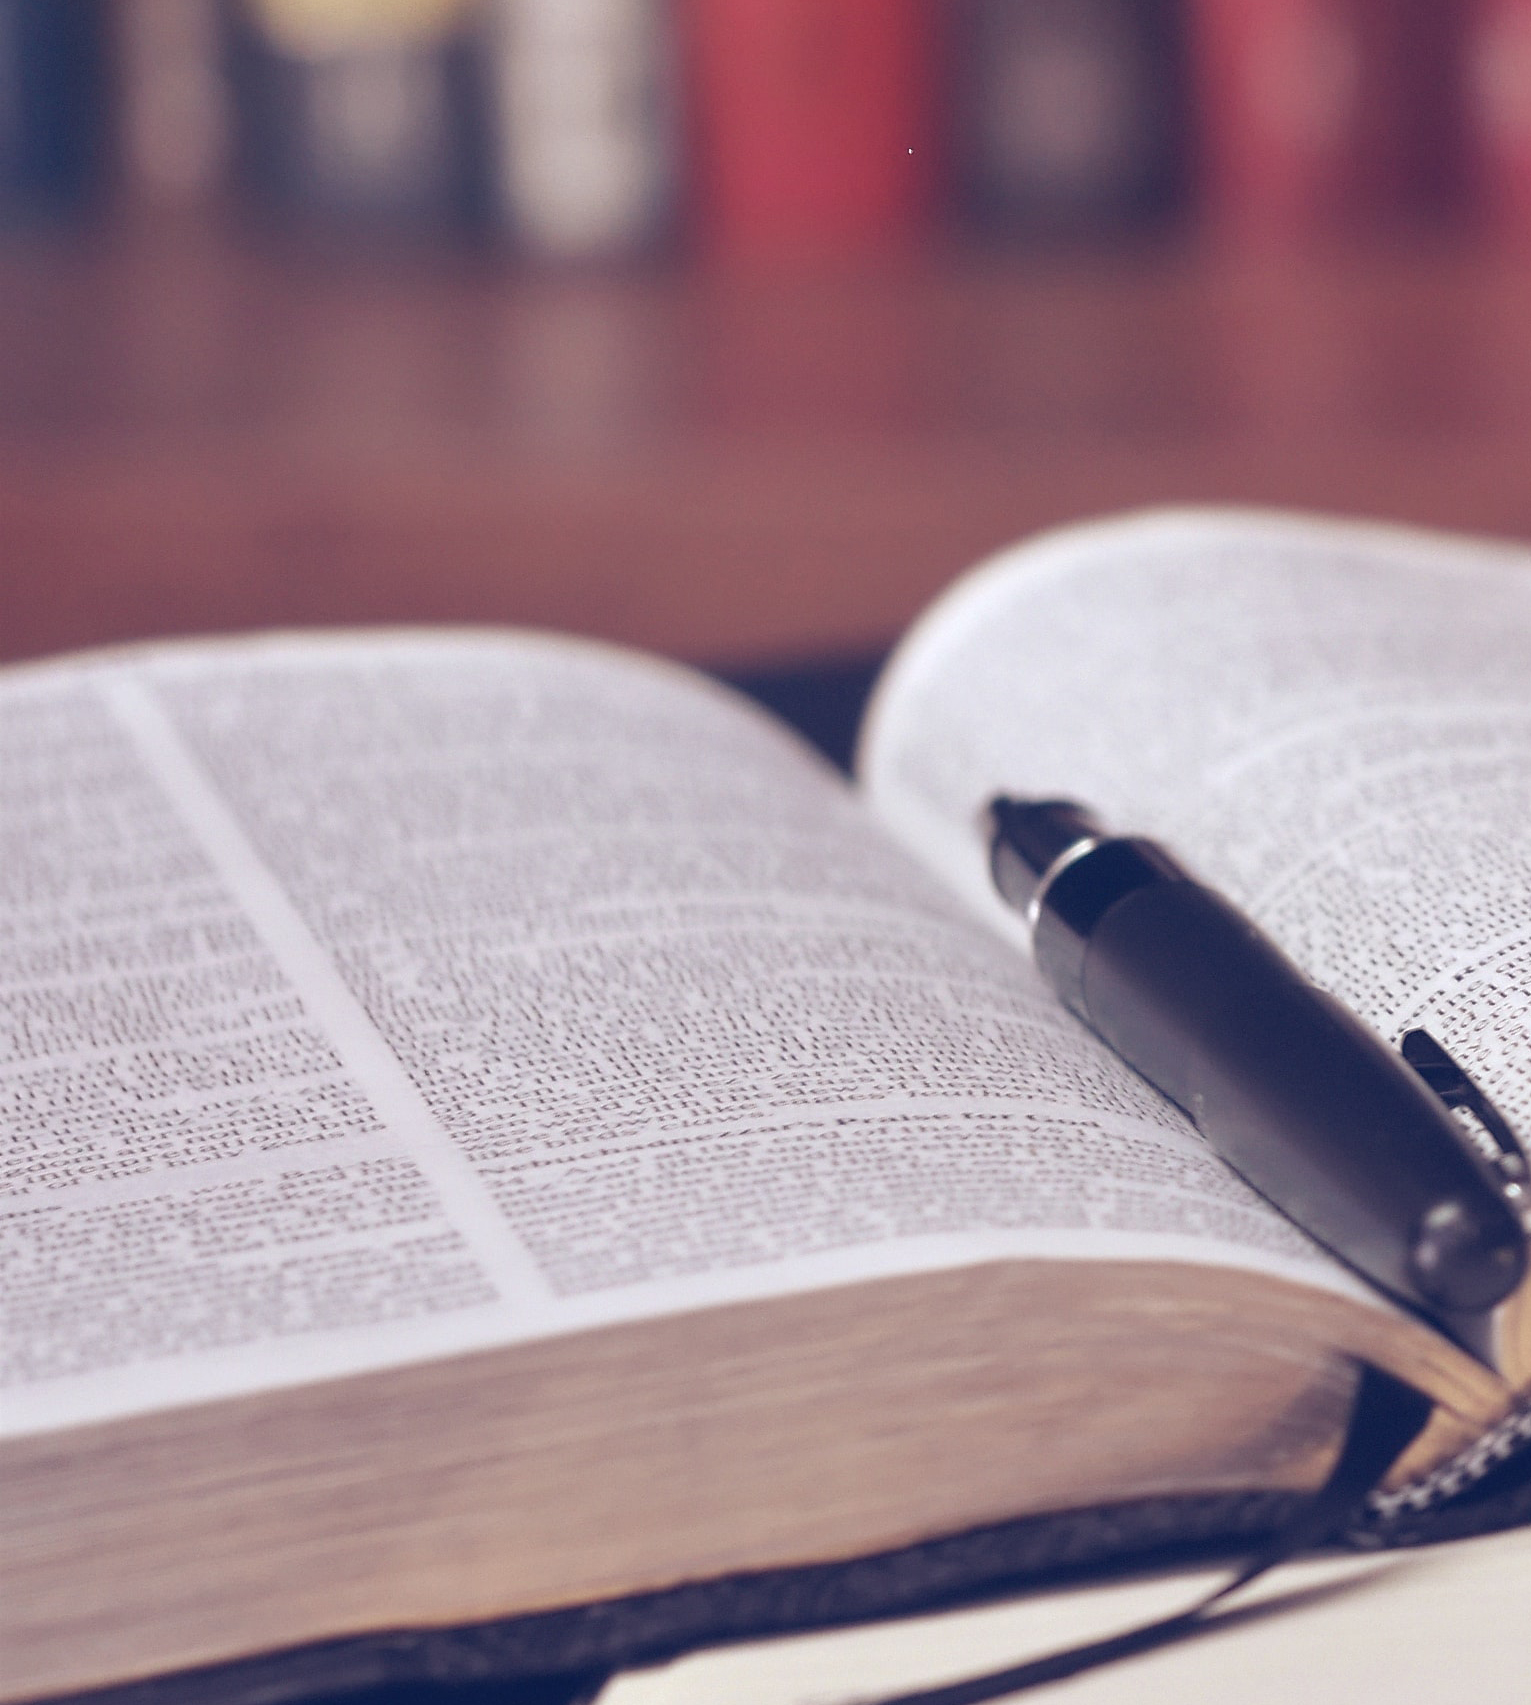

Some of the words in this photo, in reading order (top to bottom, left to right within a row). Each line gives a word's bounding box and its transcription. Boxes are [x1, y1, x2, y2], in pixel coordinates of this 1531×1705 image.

[1498, 1024, 1524, 1040] is
[424, 1084, 522, 1105] know
[508, 1093, 579, 1108] The
[552, 1100, 622, 1117] and
[635, 1089, 694, 1103] did
[705, 1082, 760, 1094] eat
[774, 1076, 877, 1088] grass
[887, 1073, 928, 1081] as
[576, 1069, 643, 1085] and
[117, 1142, 174, 1155] are
[185, 1128, 242, 1143] not
[255, 1114, 330, 1131] able
[340, 1106, 375, 1115] to
[455, 1128, 528, 1143] was
[538, 1113, 602, 1129] wet
[618, 1098, 703, 1115] with
[712, 1092, 775, 1103] the
[785, 1085, 859, 1095] dew
[873, 1080, 908, 1090] of
[460, 1135, 550, 1151] were
[561, 1114, 678, 1136] grown
[690, 1104, 759, 1117] like
[25, 1129, 309, 1183] interpretation:
[320, 1113, 381, 1129] but
[46, 1175, 83, 1188] of
[96, 1166, 154, 1179] the
[165, 1150, 243, 1167] holy
[260, 1131, 346, 1151] gods
[466, 1146, 536, 1160] like
[660, 1113, 775, 1130] claws.
